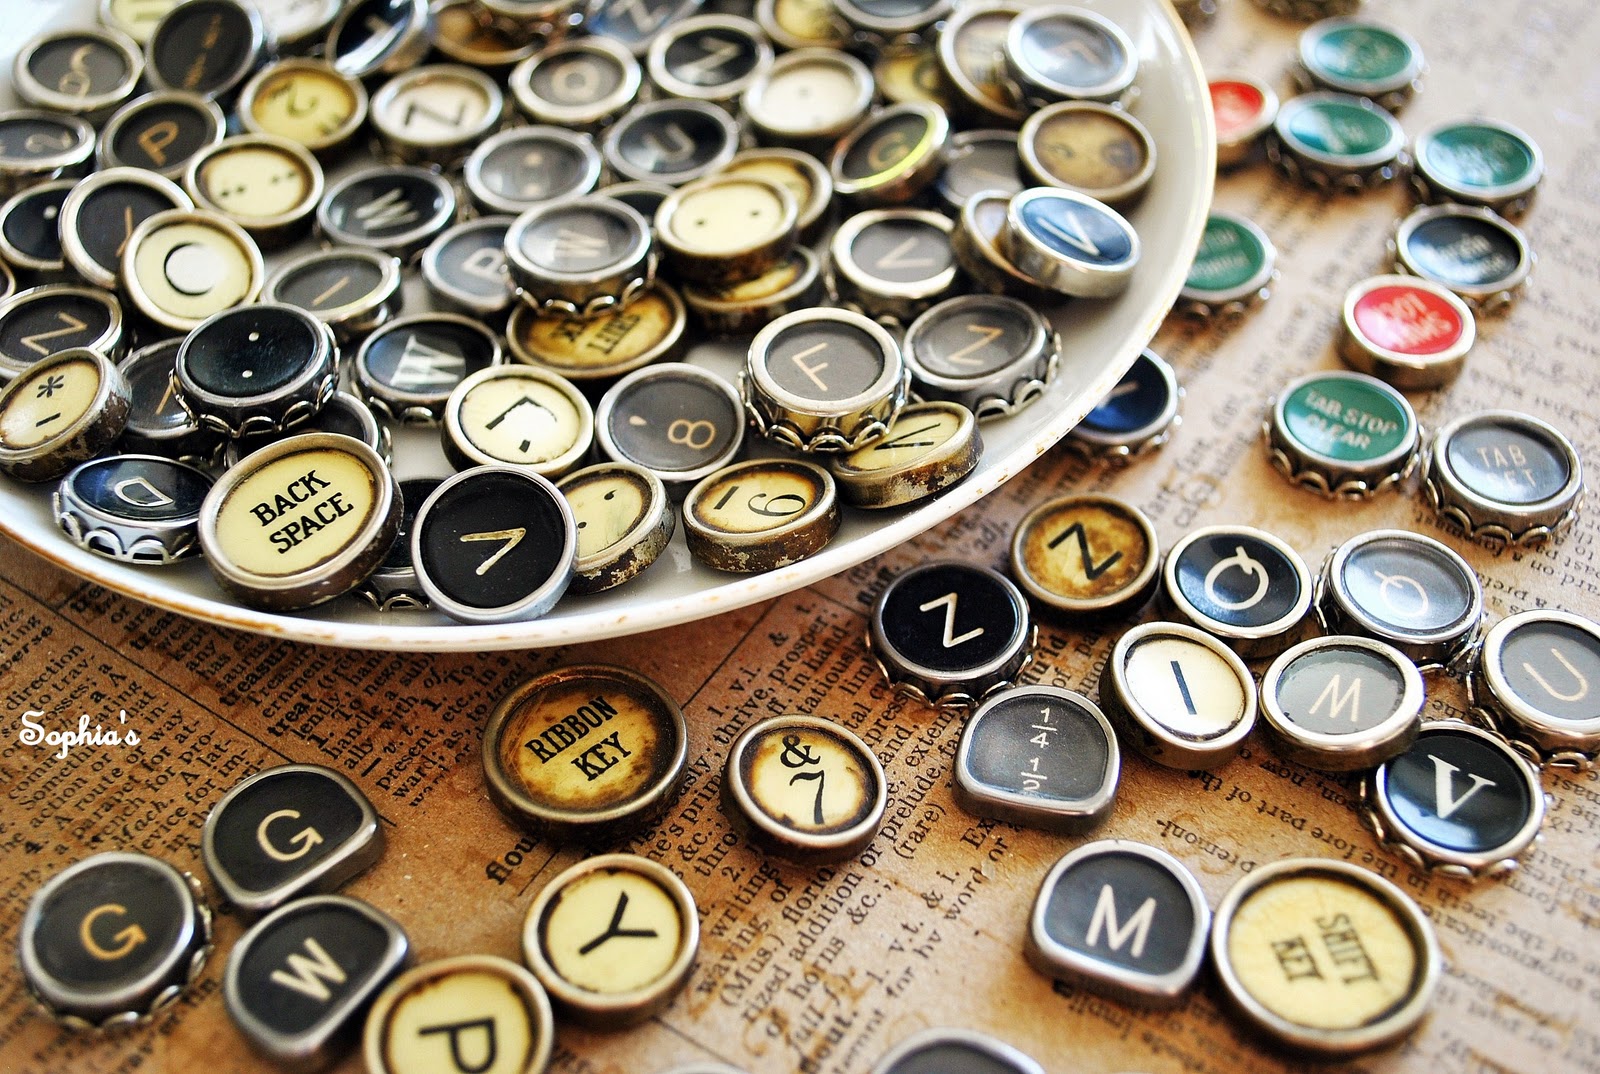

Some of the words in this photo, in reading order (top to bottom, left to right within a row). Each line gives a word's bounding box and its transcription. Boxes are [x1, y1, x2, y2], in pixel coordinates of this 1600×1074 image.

[792, 342, 829, 391] F
[668, 419, 716, 449] 8
[250, 469, 331, 527] BACK
[269, 492, 354, 554] SPACE
[1204, 546, 1269, 611] Q
[1373, 569, 1430, 617] Q
[6, 642, 85, 711] direction
[1308, 673, 1362, 723] M
[1522, 647, 1588, 701] U
[266, 692, 318, 739] treat
[323, 702, 384, 761] handle
[342, 736, 374, 771] ally
[379, 693, 417, 732] with
[524, 696, 619, 764] RIBBON
[712, 683, 777, 747] thrive,
[74, 765, 125, 813] route
[125, 744, 147, 765] or
[148, 708, 185, 744] way
[144, 764, 177, 792] for
[178, 726, 217, 766] pro-
[179, 769, 200, 788] A
[184, 777, 217, 807] for
[217, 746, 249, 779] im-
[375, 725, 446, 792] present,
[391, 749, 446, 799] ward;
[570, 730, 633, 781] KEY
[779, 733, 821, 769] &
[29, 775, 89, 829] action
[71, 774, 143, 840] parapet
[141, 744, 172, 774] for
[788, 770, 826, 825] 7
[1427, 754, 1498, 819] V
[256, 808, 324, 863] G
[645, 822, 685, 862] ne's
[895, 800, 949, 861] (rare)
[1263, 800, 1305, 833] part
[768, 876, 794, 904] of
[788, 872, 862, 963] addition
[859, 841, 883, 868] or
[877, 762, 946, 844] prelude,
[579, 890, 659, 956] Y
[708, 860, 781, 939] writing
[924, 888, 945, 911] &
[1085, 883, 1157, 960] M
[80, 903, 147, 961] G
[1315, 912, 1380, 986] SHIFT
[270, 937, 347, 1000] W
[418, 1016, 498, 1074] P
